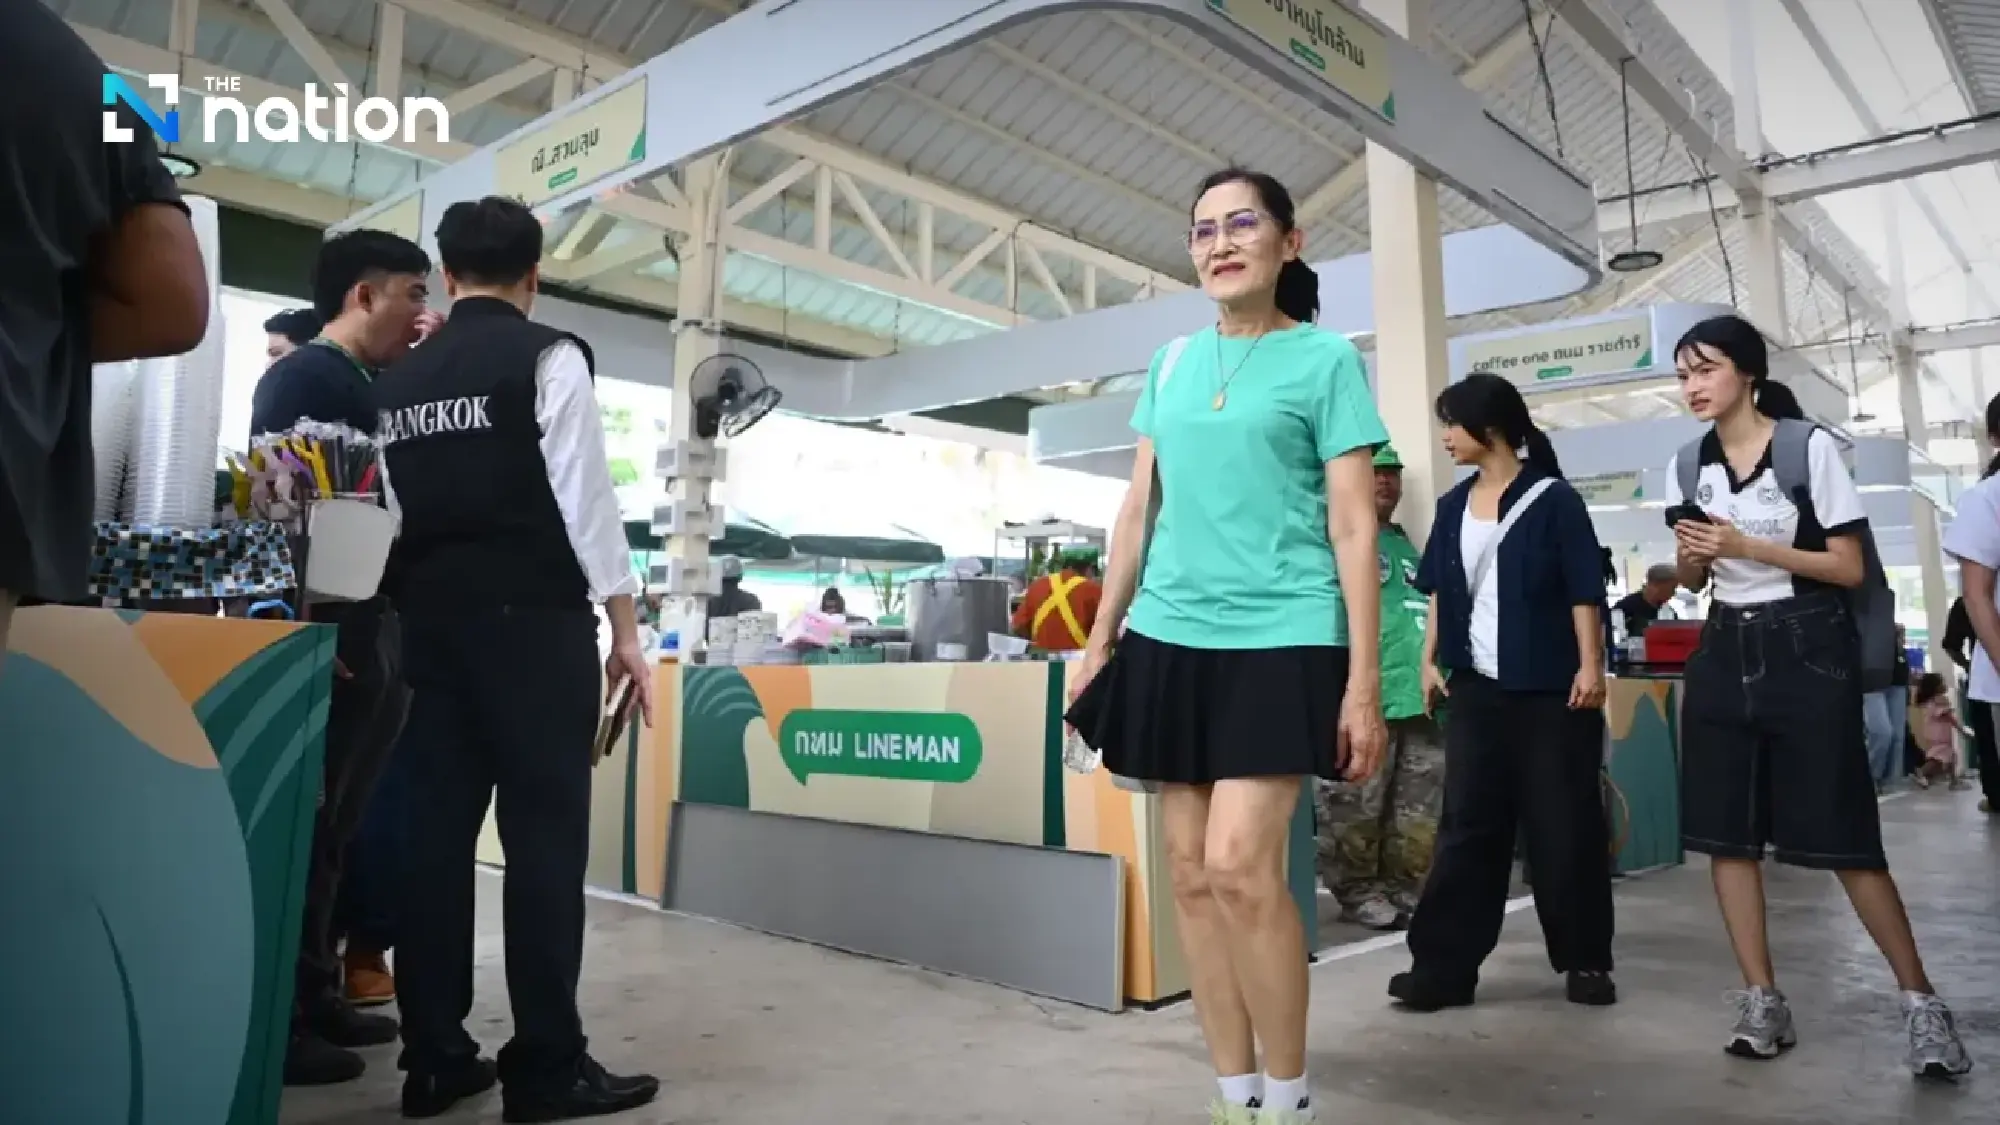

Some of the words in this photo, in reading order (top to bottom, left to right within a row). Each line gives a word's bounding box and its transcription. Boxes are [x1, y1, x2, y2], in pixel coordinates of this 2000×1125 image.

[1265, 0, 1365, 69] ขาหมูโกล้าน
[1473, 355, 1518, 372] coffee
[1522, 351, 1549, 365] one
[378, 395, 492, 445] BANGKOK
[794, 730, 843, 757] กทม
